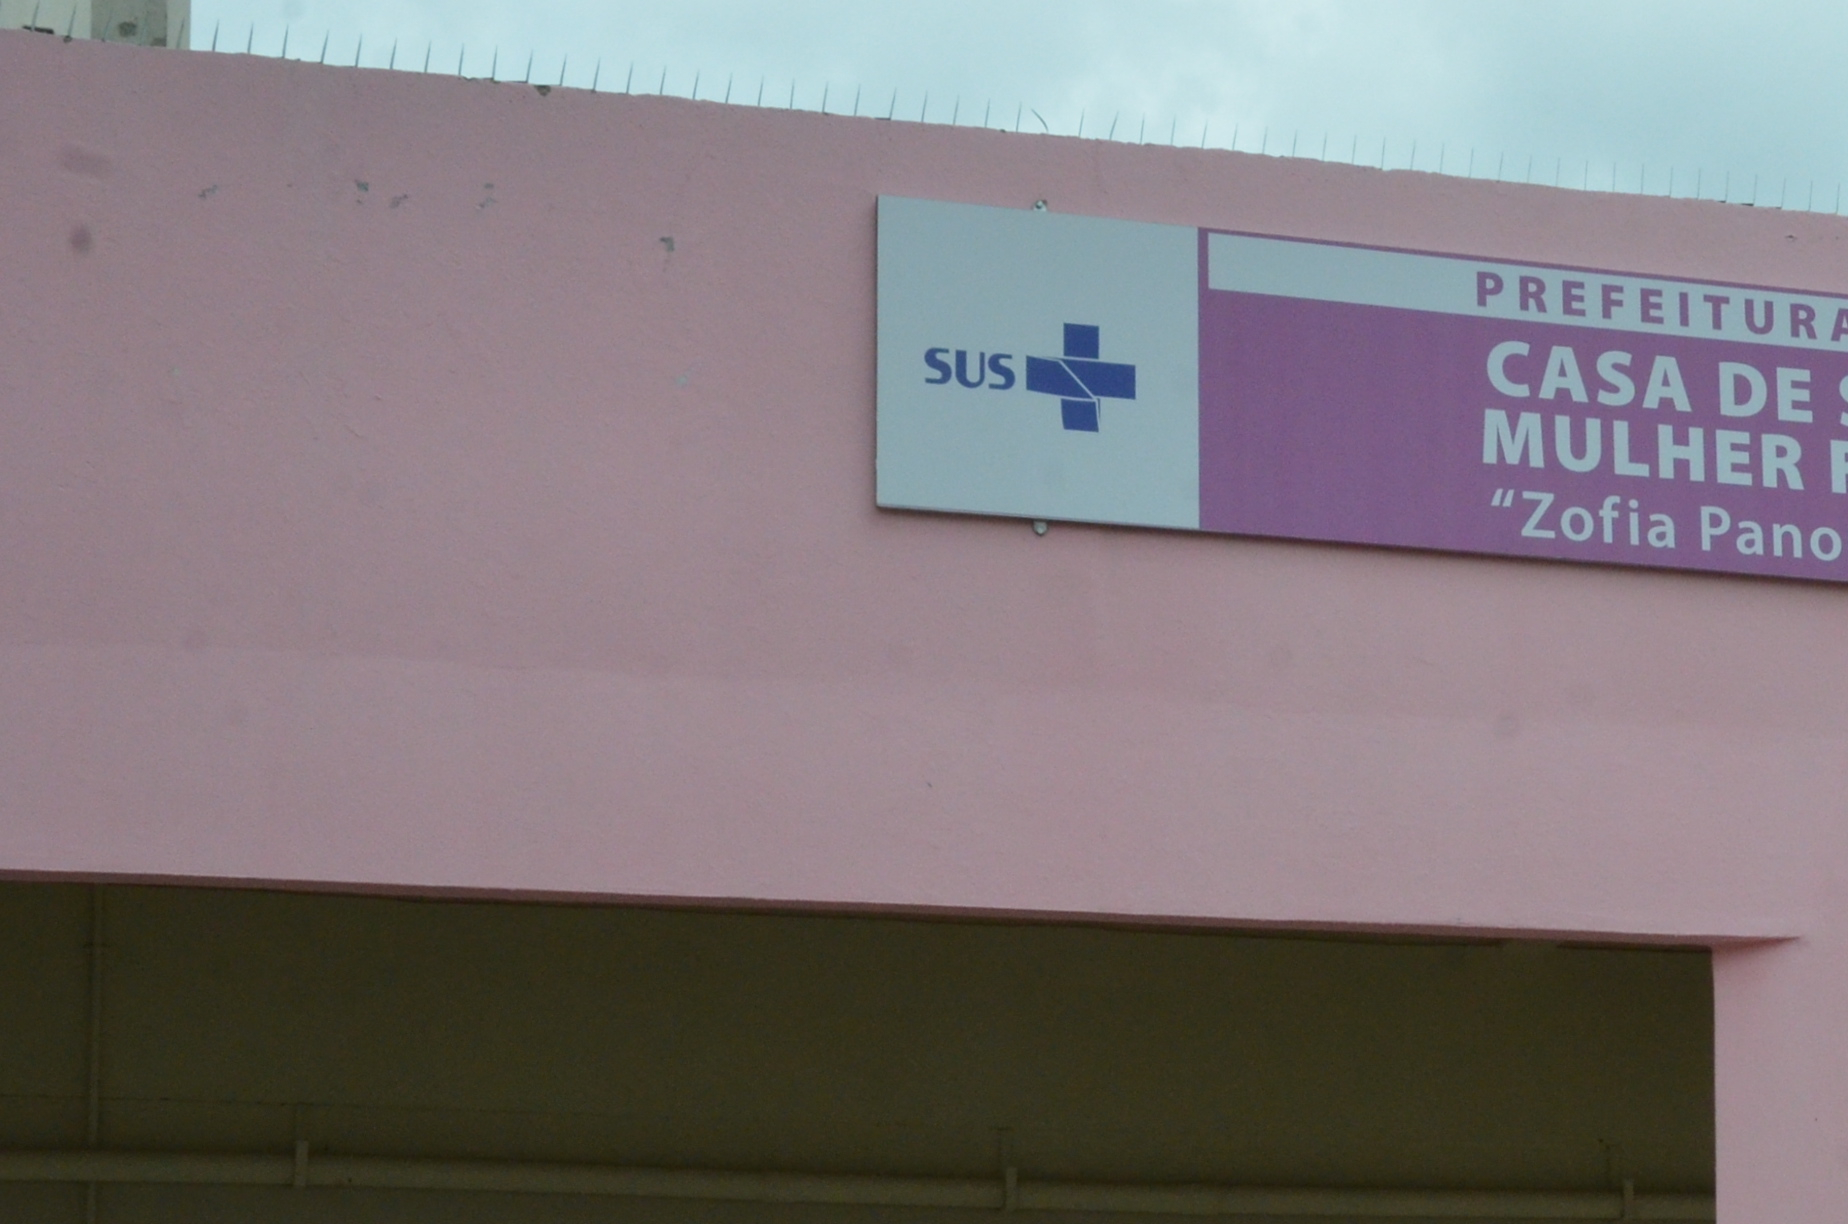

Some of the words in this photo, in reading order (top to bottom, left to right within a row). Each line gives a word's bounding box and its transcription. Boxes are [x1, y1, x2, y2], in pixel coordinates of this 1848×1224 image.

[924, 347, 1016, 391] SUS
[1486, 340, 1692, 412] CASA
[1718, 361, 1814, 423] DE
[1482, 408, 1805, 491] MULHER
[1490, 488, 1676, 549] “Zofia
